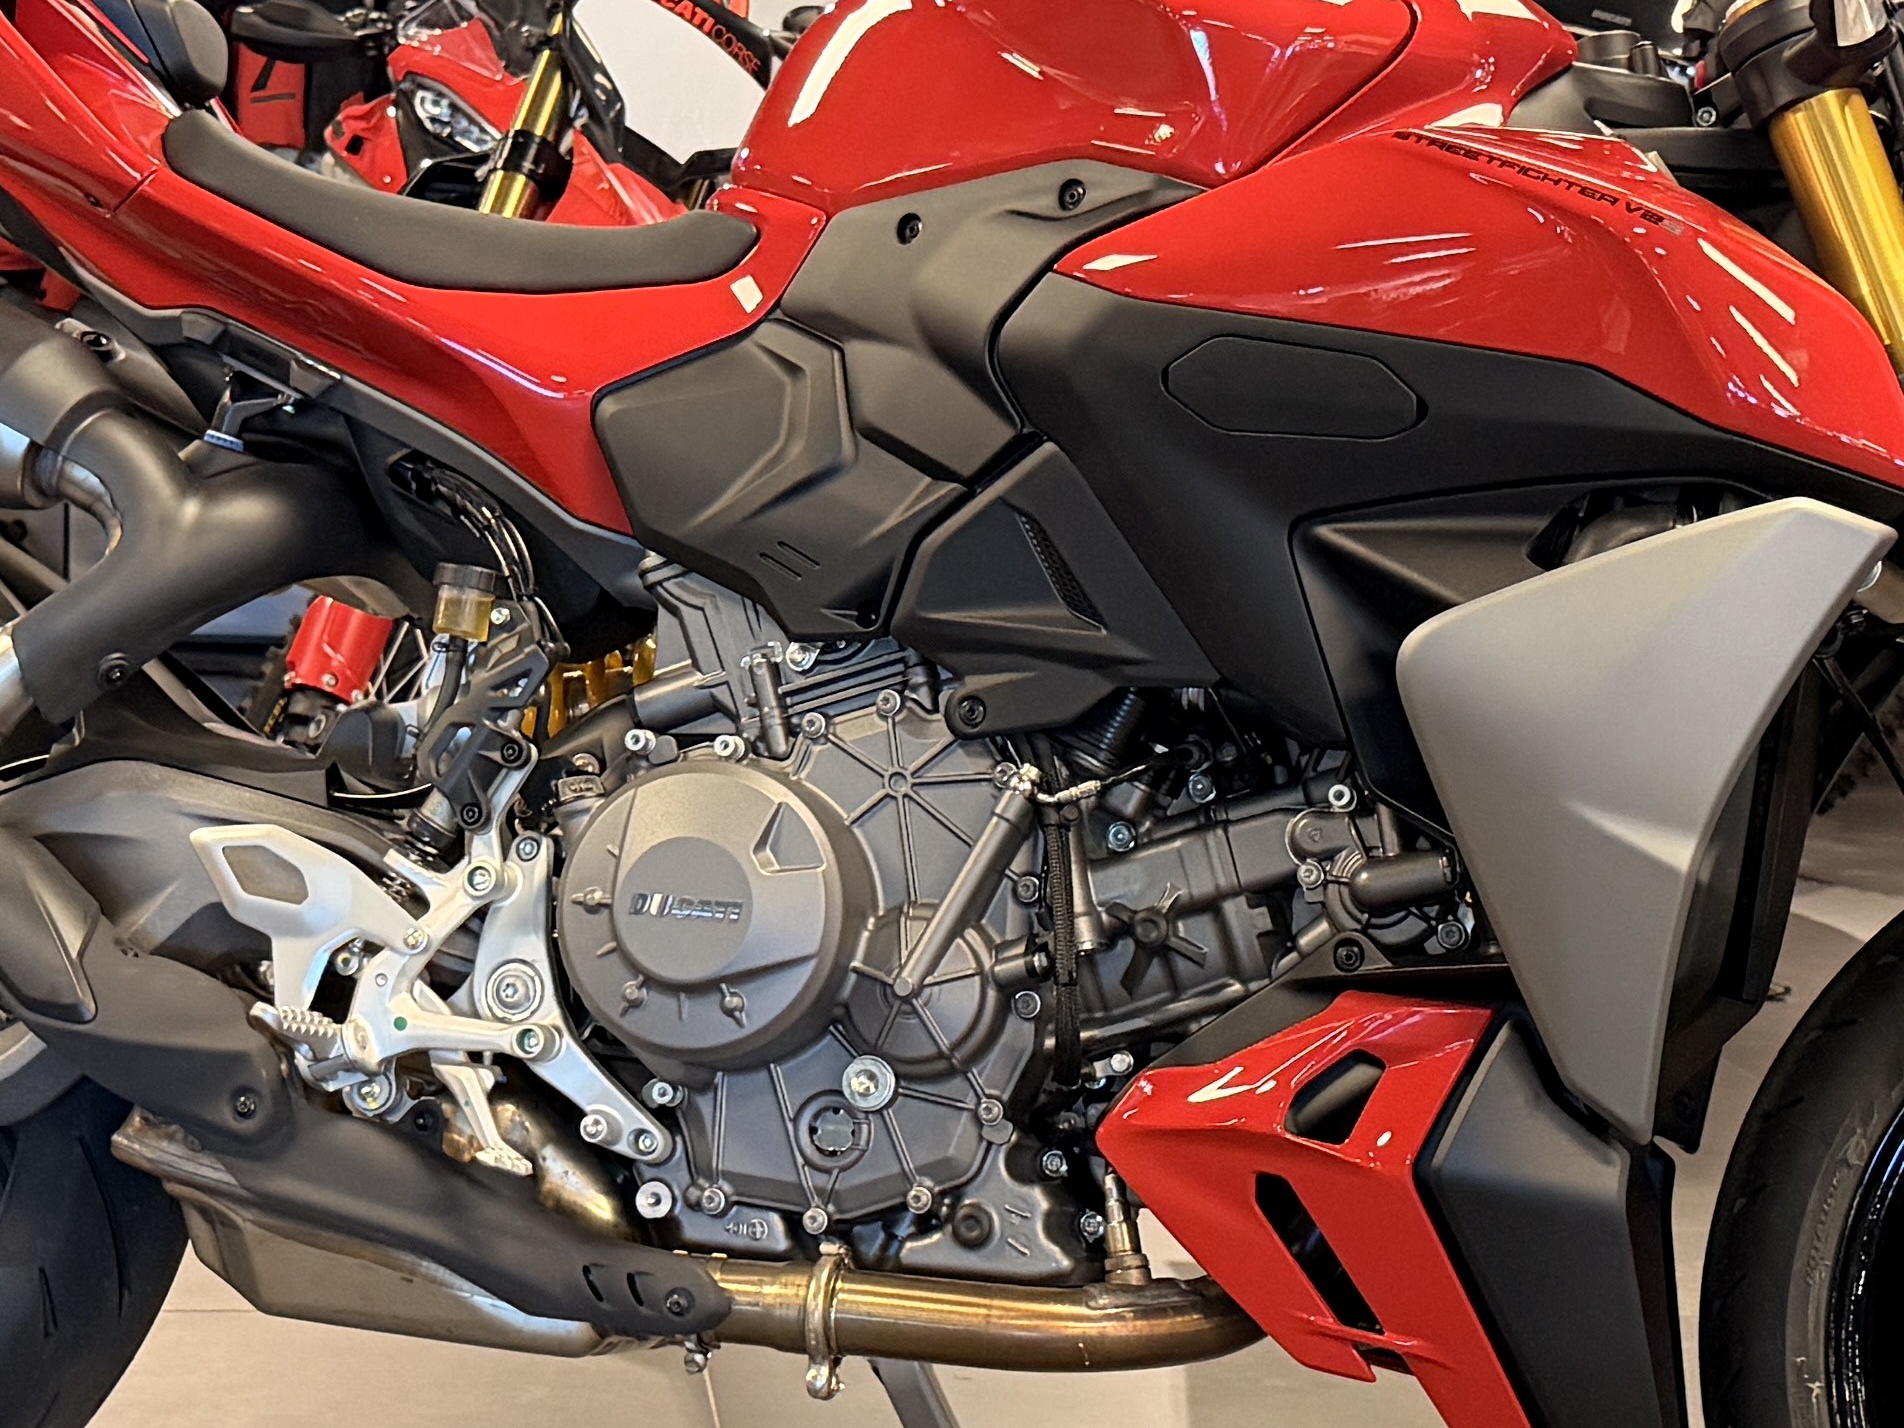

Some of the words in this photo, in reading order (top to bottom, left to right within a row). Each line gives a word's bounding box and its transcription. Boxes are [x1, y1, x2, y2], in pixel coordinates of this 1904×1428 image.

[711, 24, 761, 73] CORSE
[1392, 129, 1620, 206] STREETFIGHTER
[628, 892, 744, 923] DUCATI
